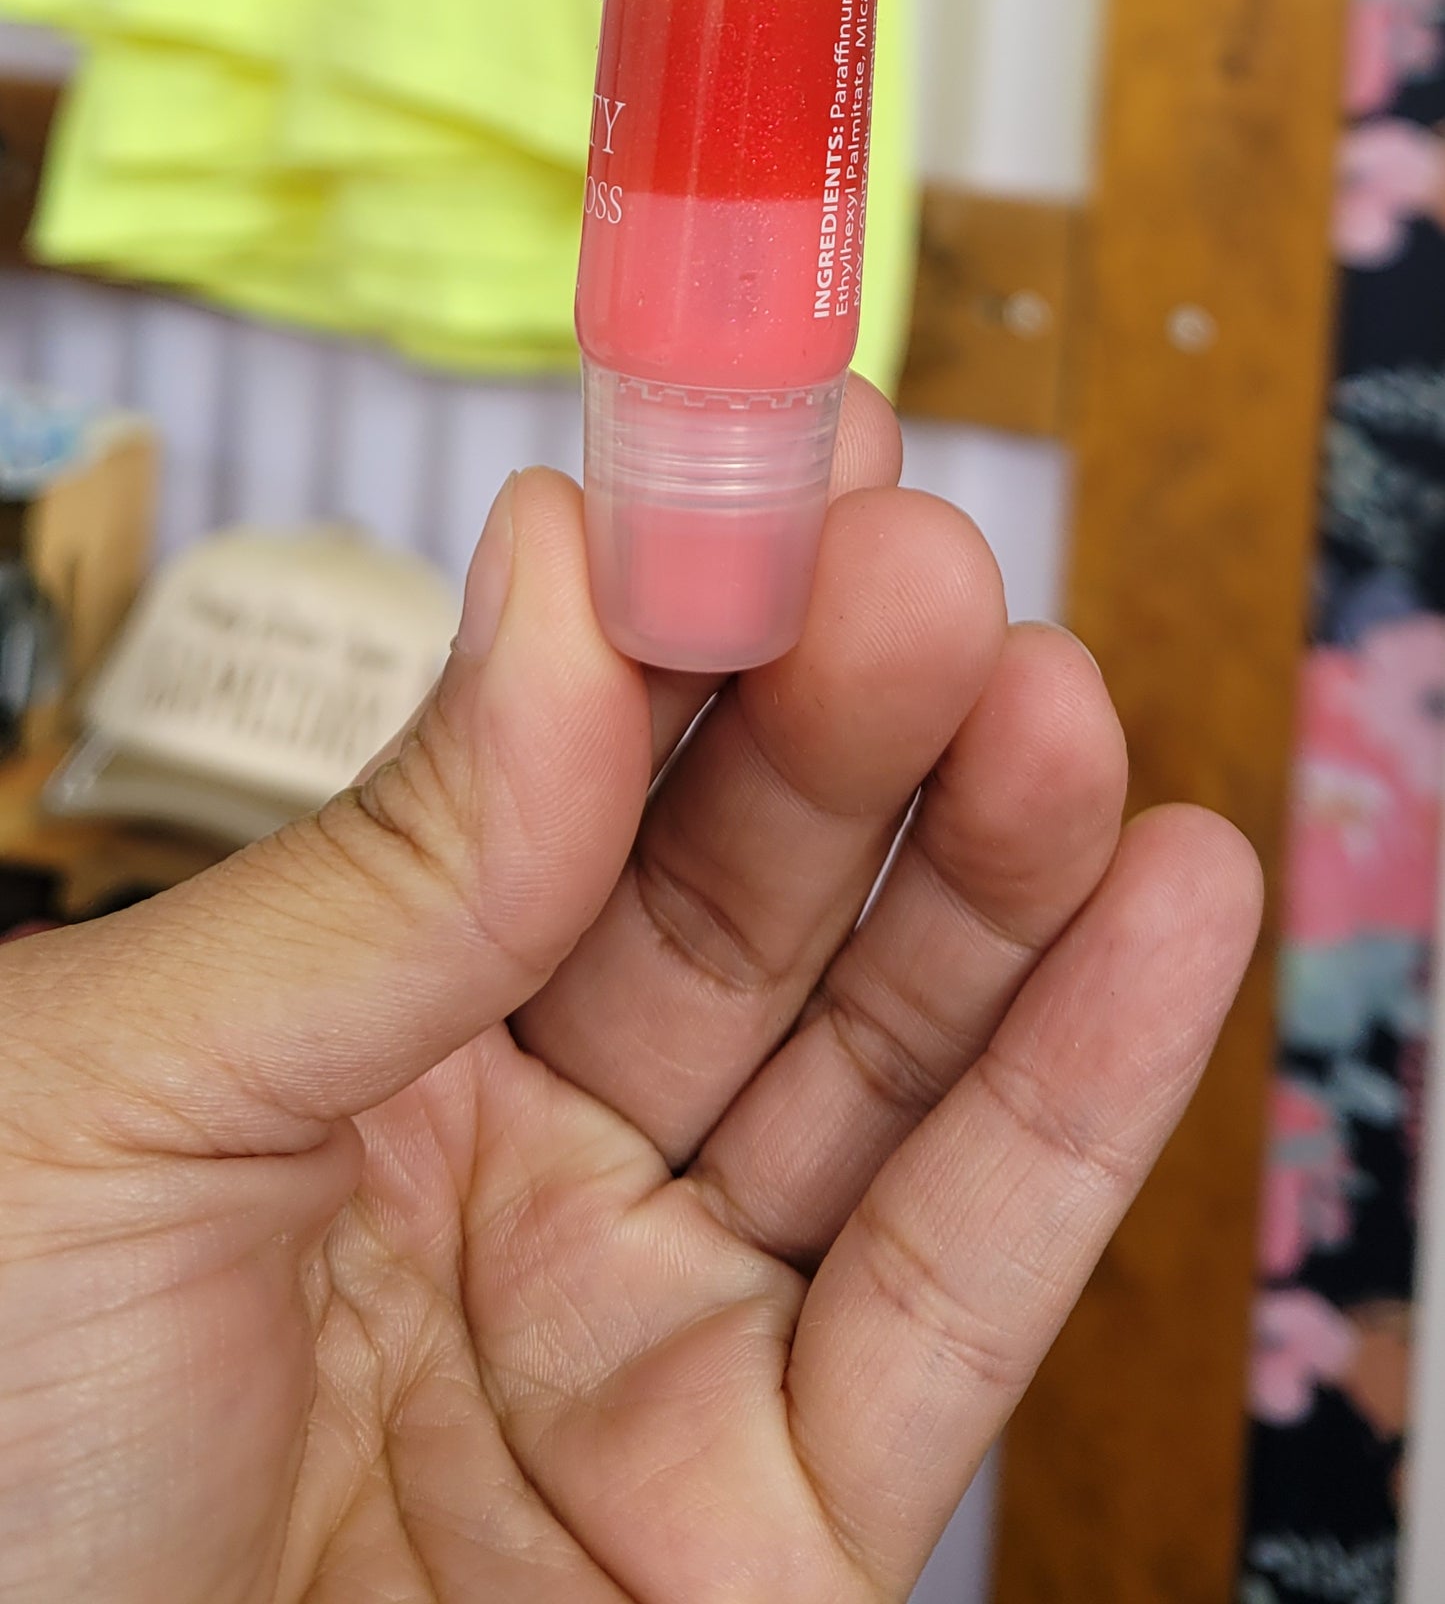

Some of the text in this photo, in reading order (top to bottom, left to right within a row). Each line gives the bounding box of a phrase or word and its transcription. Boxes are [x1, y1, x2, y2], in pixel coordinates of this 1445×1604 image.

[846, 54, 867, 180] Palmitate,
[813, 125, 845, 319] INGREDIENTS:
[835, 187, 859, 317] Ethylhexyl
